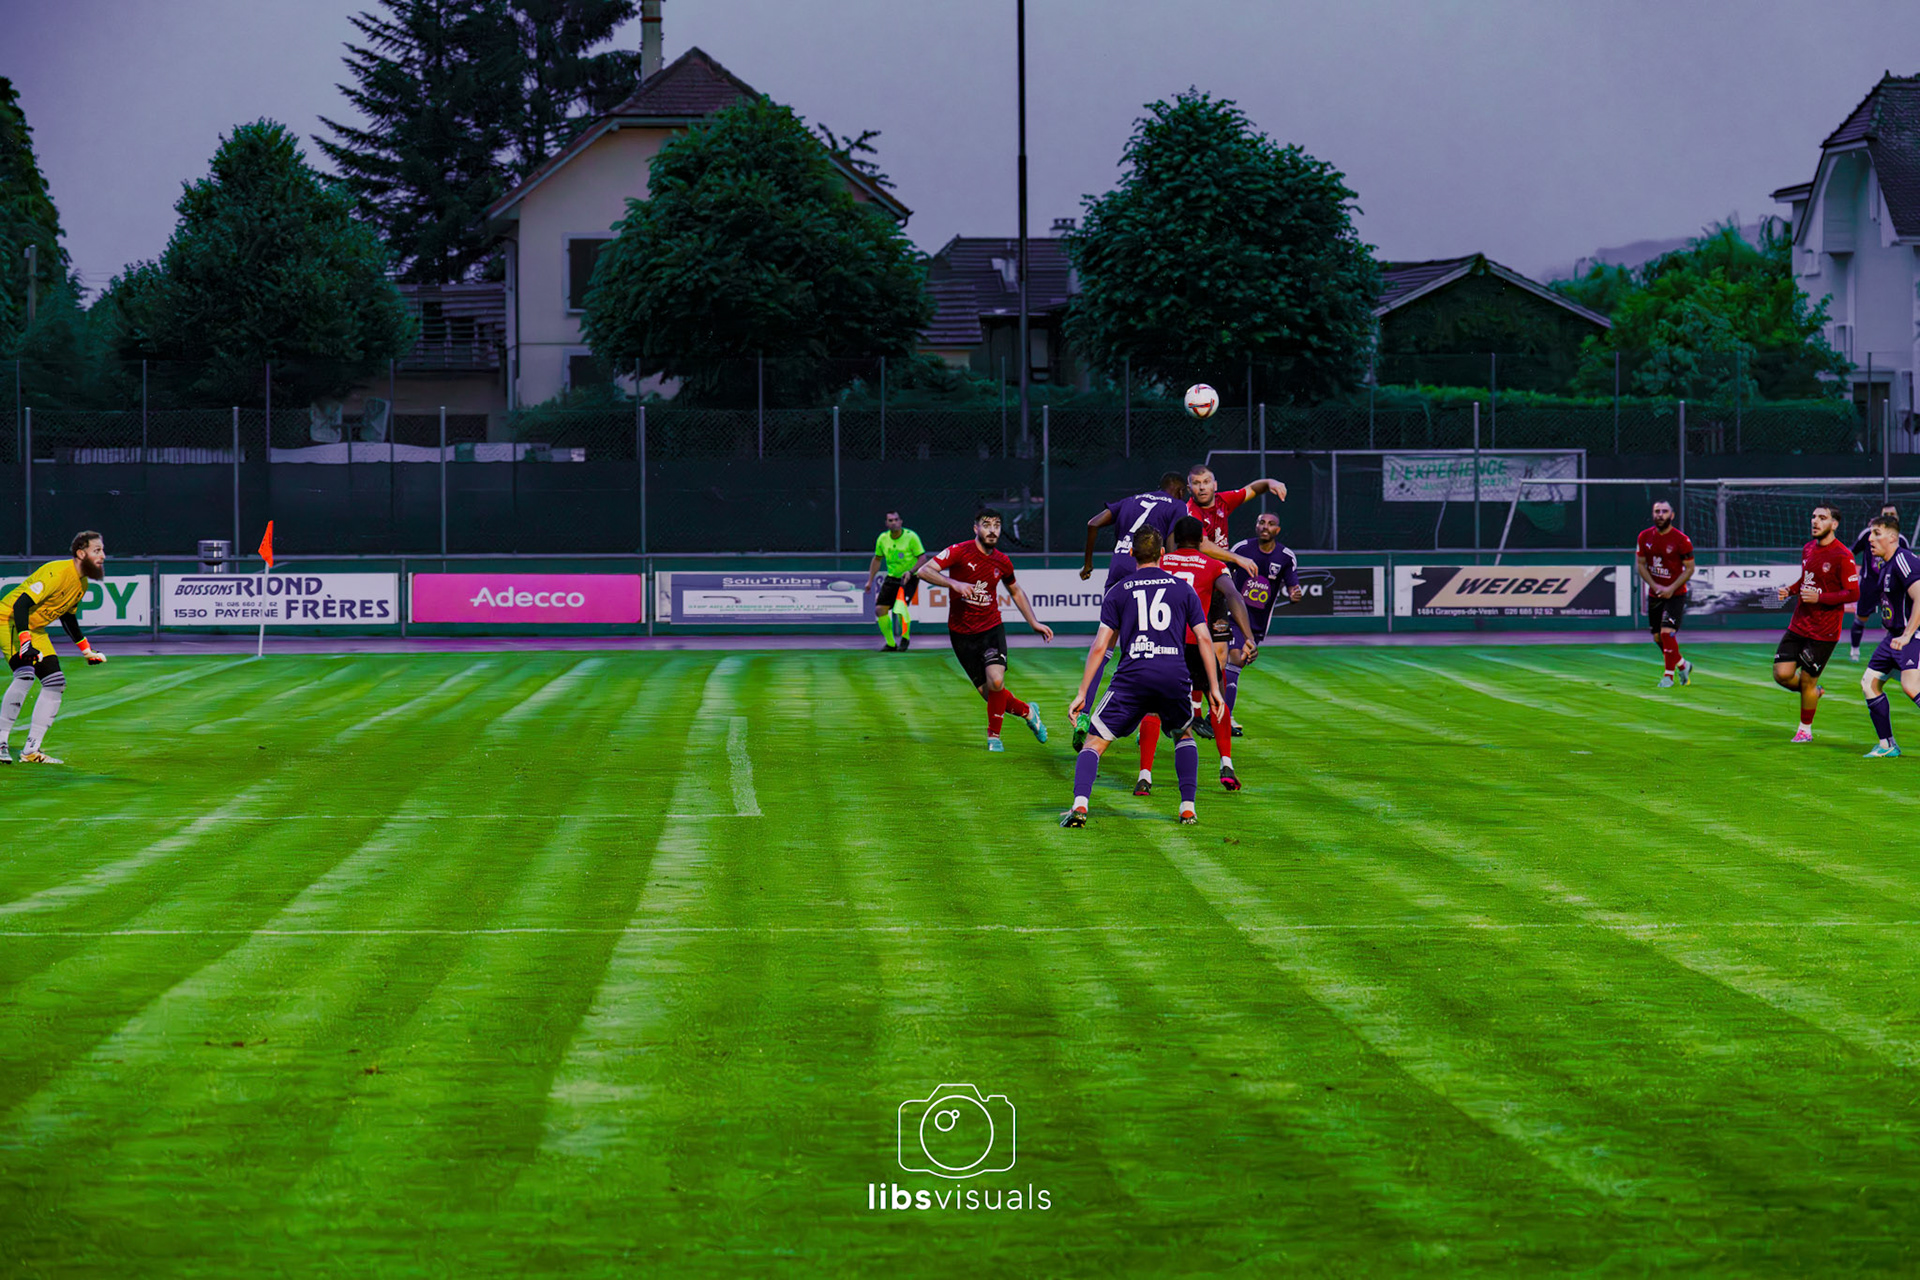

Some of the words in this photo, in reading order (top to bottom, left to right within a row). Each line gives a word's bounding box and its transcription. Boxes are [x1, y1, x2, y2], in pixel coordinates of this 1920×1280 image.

[1129, 500, 1158, 534] 7
[174, 584, 235, 596] BOISSONS
[235, 577, 323, 598] RIOND
[1134, 578, 1177, 587] HONDA
[1455, 577, 1572, 595] WEIBEL
[469, 586, 585, 608] Adecco
[1032, 594, 1103, 607] MIAUTO
[1248, 588, 1269, 603] CO
[173, 608, 208, 618] 1530
[215, 608, 279, 618] PAYERNE
[285, 594, 390, 620] FRÈRES
[1132, 587, 1172, 632] 16
